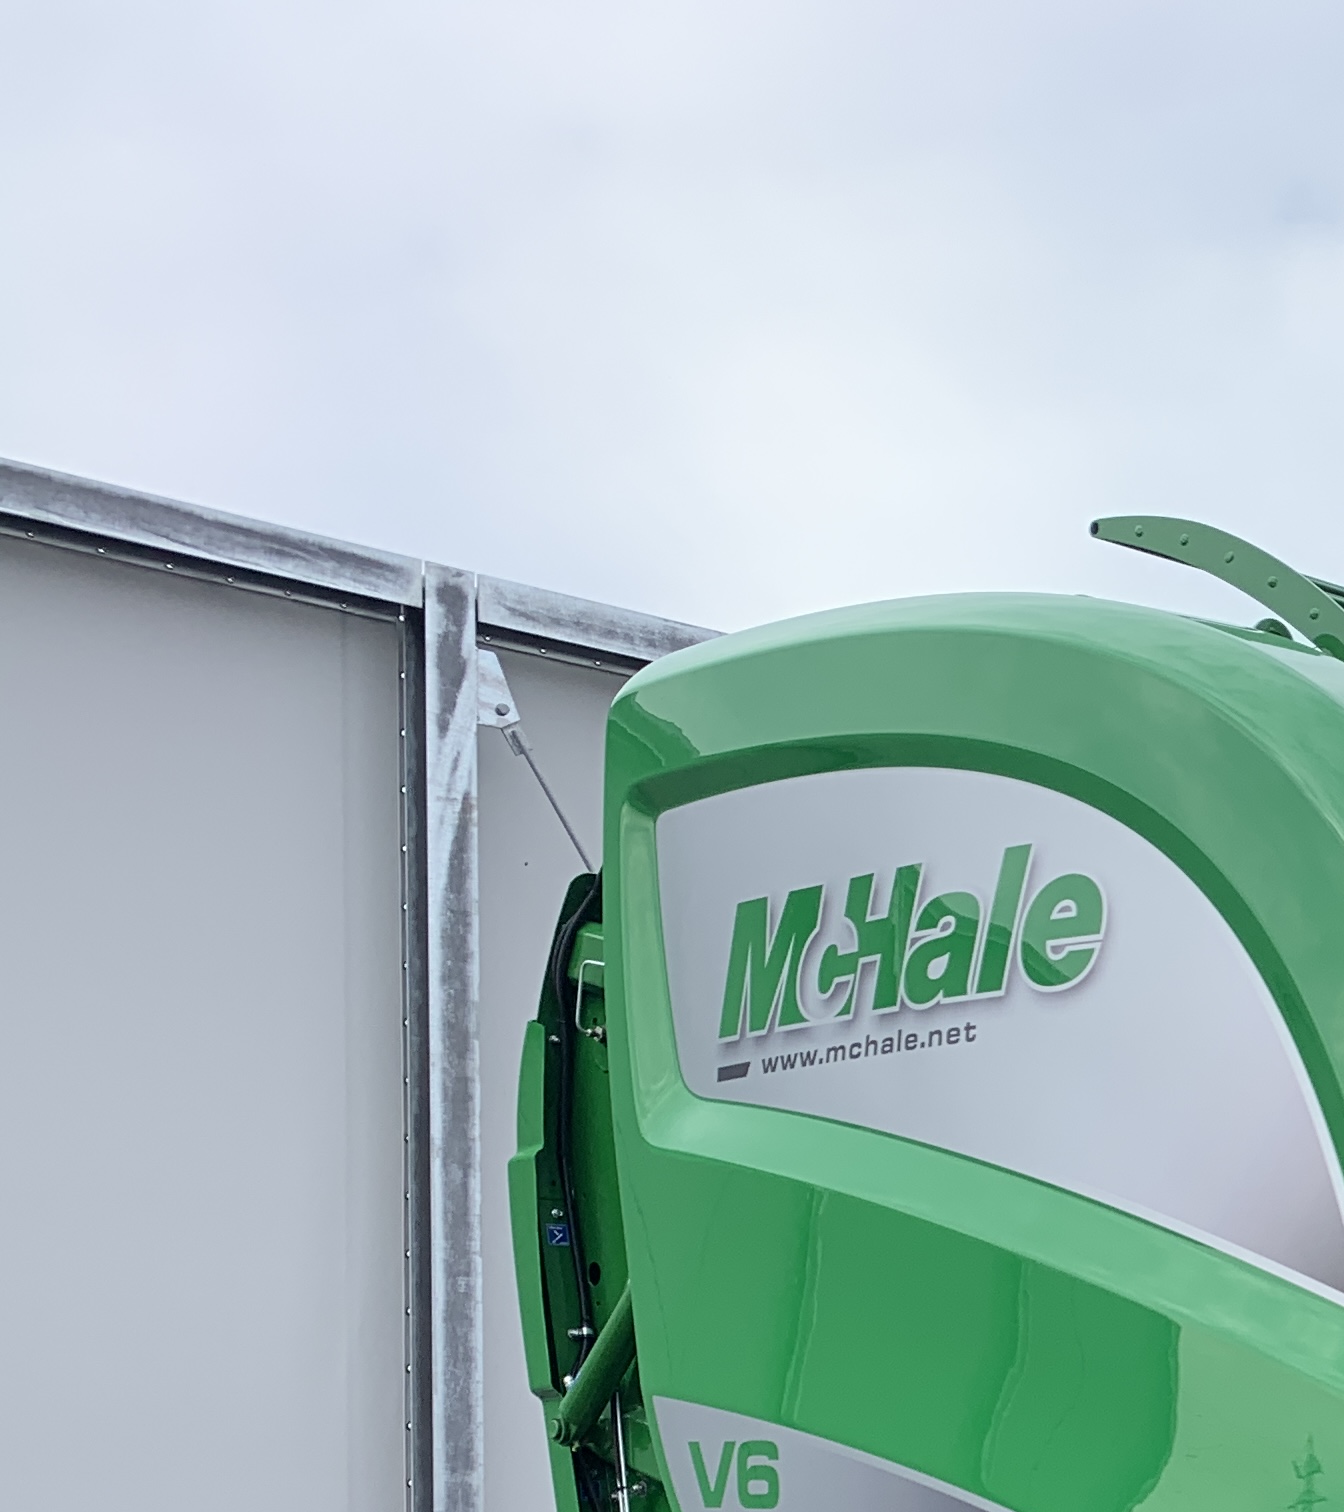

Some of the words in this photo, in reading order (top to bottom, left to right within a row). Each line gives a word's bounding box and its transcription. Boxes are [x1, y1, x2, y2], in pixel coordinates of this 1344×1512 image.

[717, 842, 1107, 1043] McHale
[760, 1020, 978, 1075] www.mchale.net
[687, 1439, 781, 1510] V6
